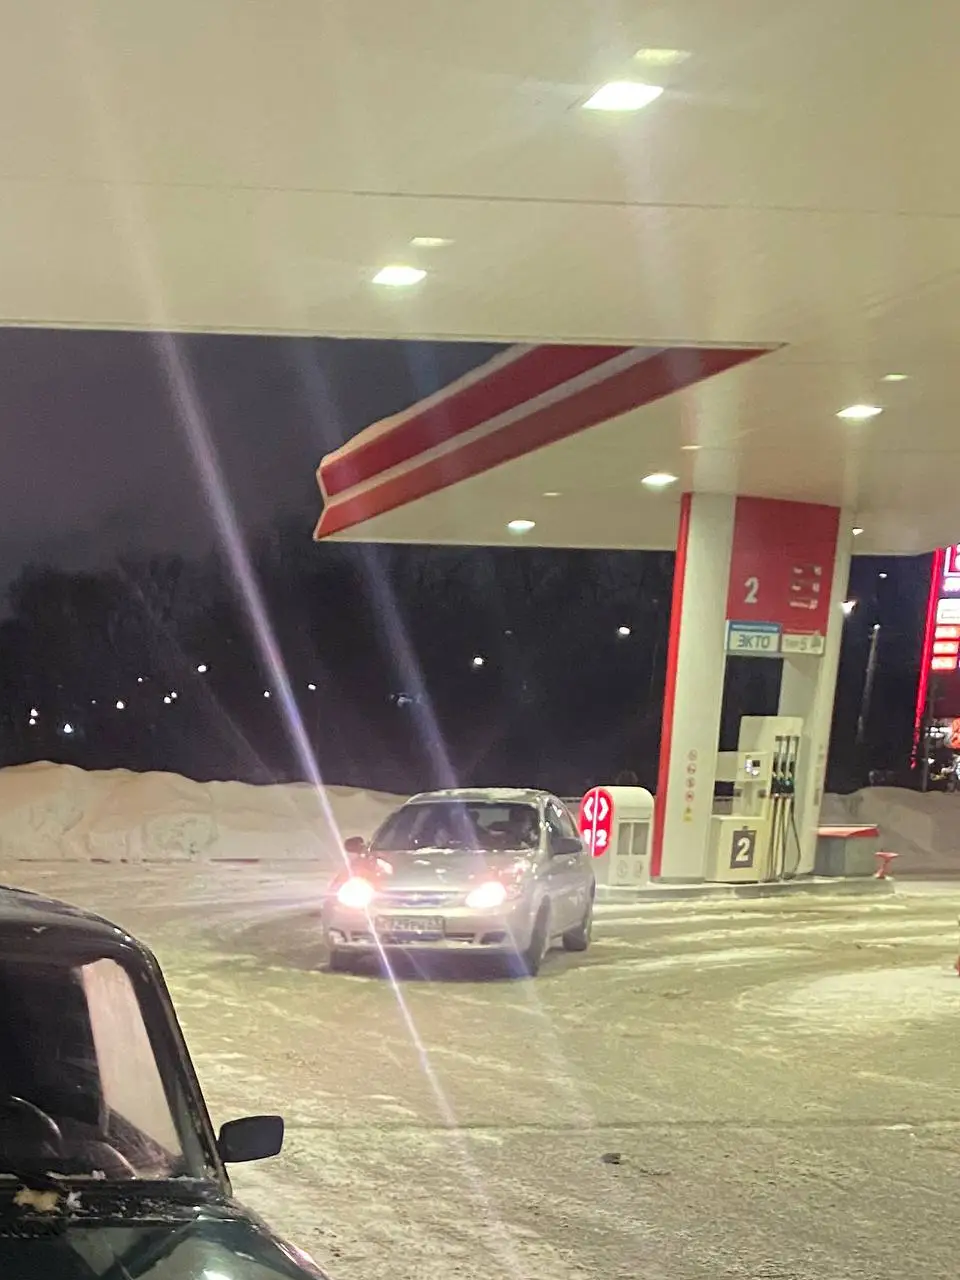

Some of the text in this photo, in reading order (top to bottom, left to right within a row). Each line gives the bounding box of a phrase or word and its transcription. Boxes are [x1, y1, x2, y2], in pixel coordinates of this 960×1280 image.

[744, 577, 759, 604] 2
[737, 634, 771, 649] ЭКТО
[596, 829, 608, 847] 2
[735, 837, 750, 861] 2
